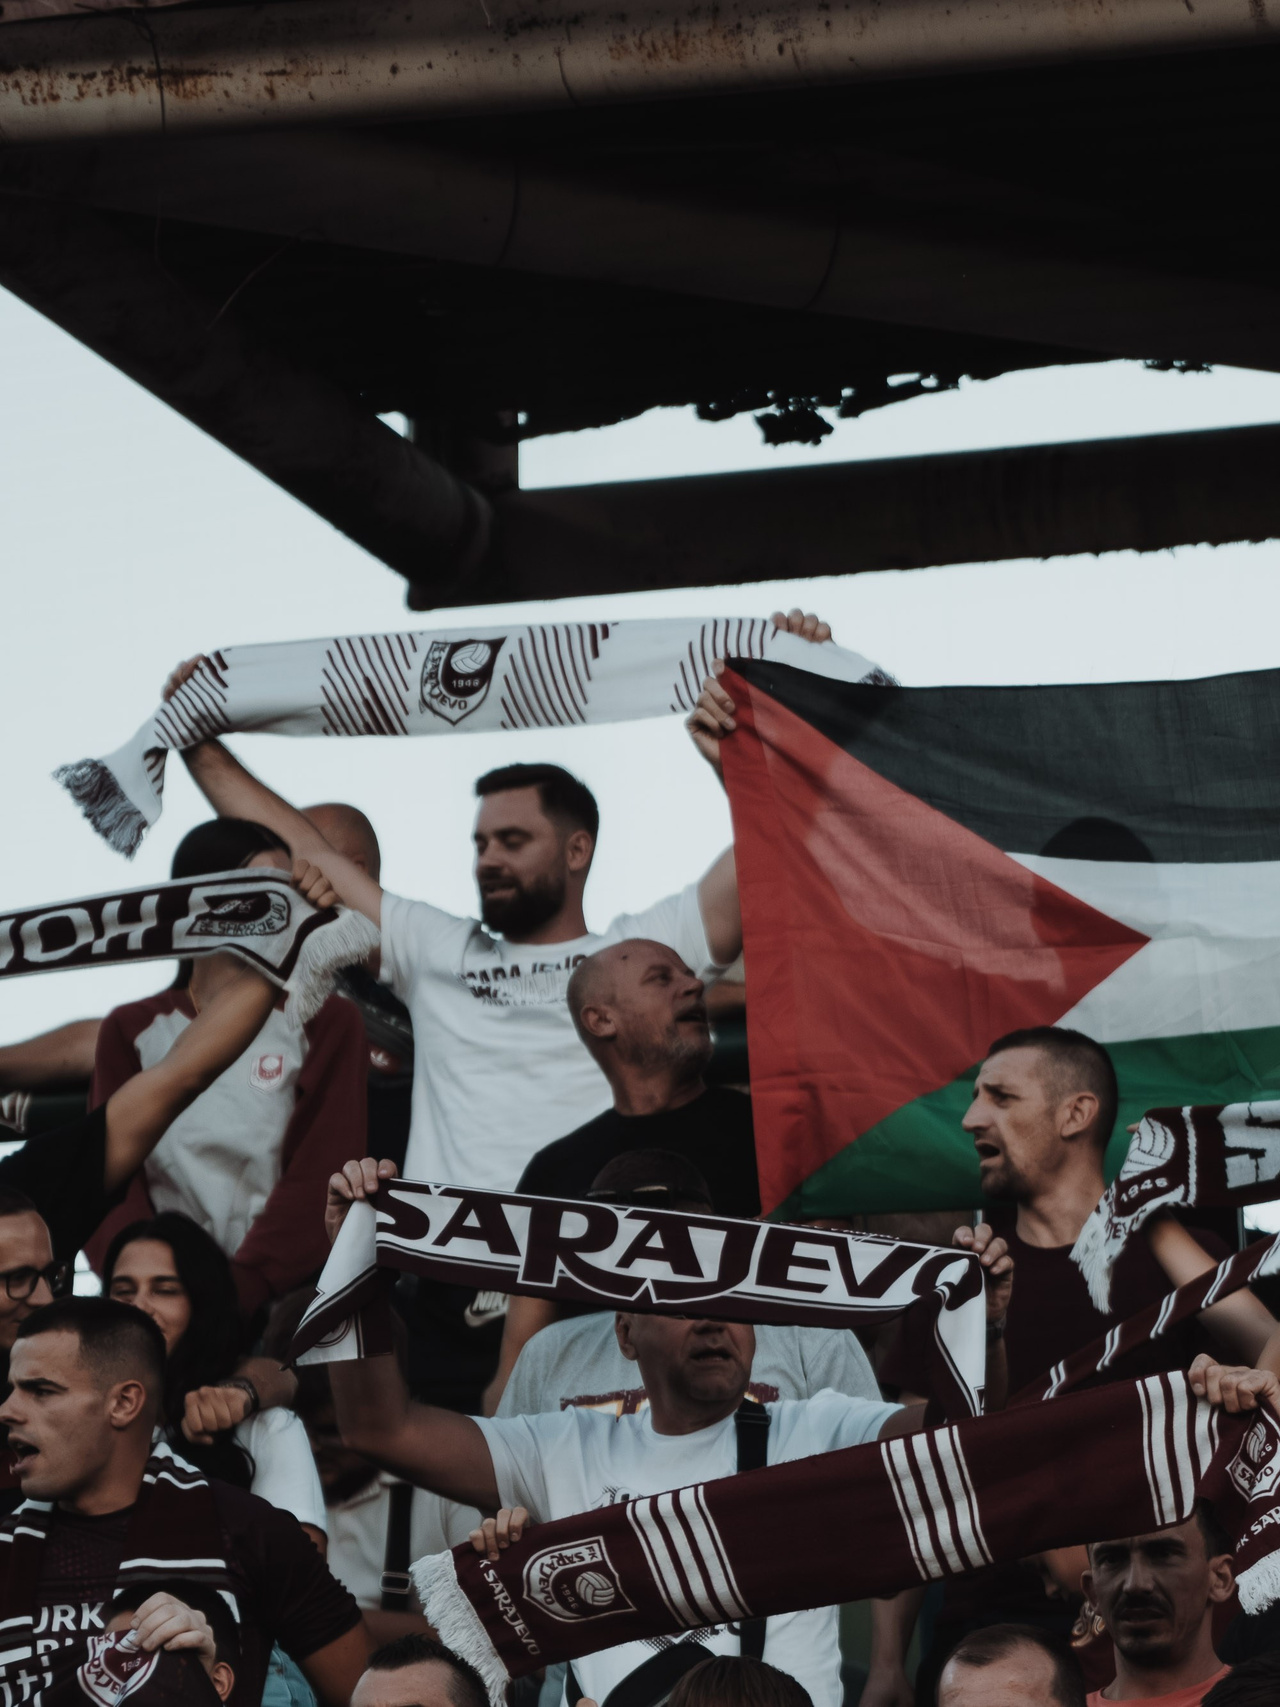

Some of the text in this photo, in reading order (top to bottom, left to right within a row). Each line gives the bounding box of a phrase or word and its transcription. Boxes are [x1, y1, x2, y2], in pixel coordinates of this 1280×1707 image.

[376, 1181, 985, 1311] SARAJEVO
[538, 1549, 585, 1606] SARAJEVO
[585, 1546, 599, 1561] FK
[483, 1569, 541, 1656] SARAJEVO
[560, 1583, 579, 1610] 1946
